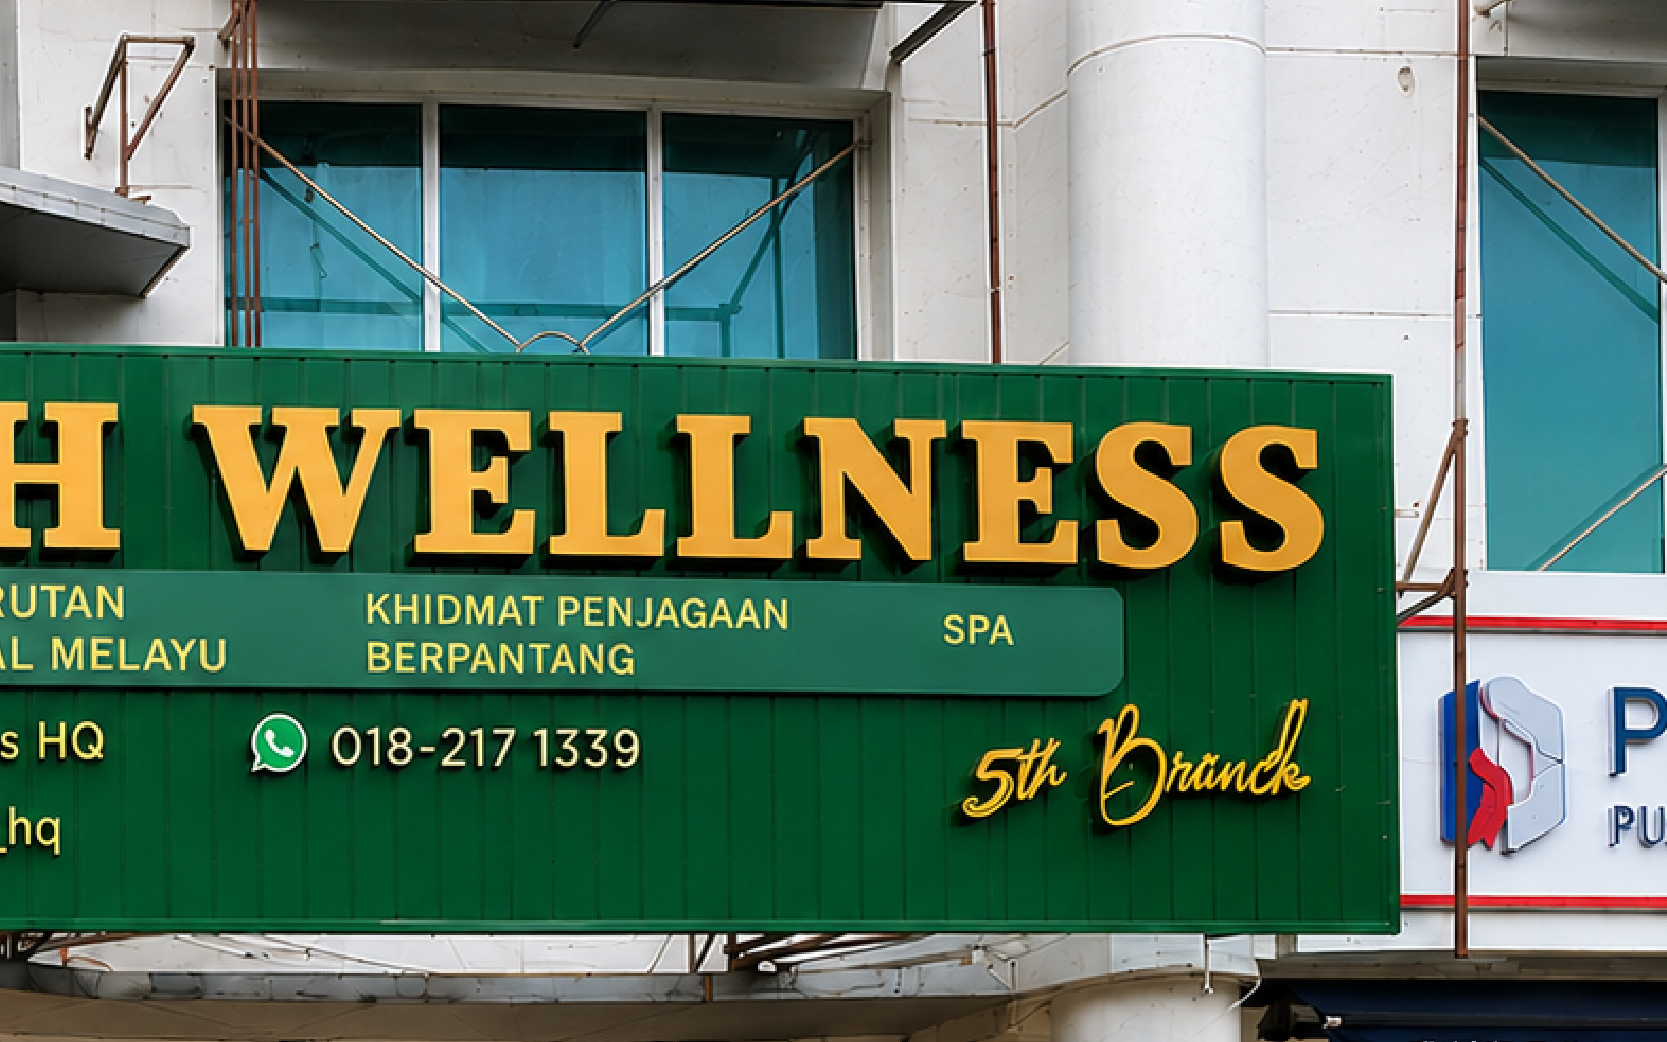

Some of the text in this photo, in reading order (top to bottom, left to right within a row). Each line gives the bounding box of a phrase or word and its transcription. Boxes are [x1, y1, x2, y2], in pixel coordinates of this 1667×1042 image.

[192, 404, 1326, 573] WELLNESS
[366, 592, 789, 631] KHIDMAT PENJAGAAN
[942, 613, 1015, 647] SPA
[50, 638, 226, 672] MELAYU
[366, 642, 635, 677] BERPANTANG
[37, 720, 105, 765] HQ
[332, 725, 641, 768] 018-217 1339
[961, 737, 1069, 819] 5th
